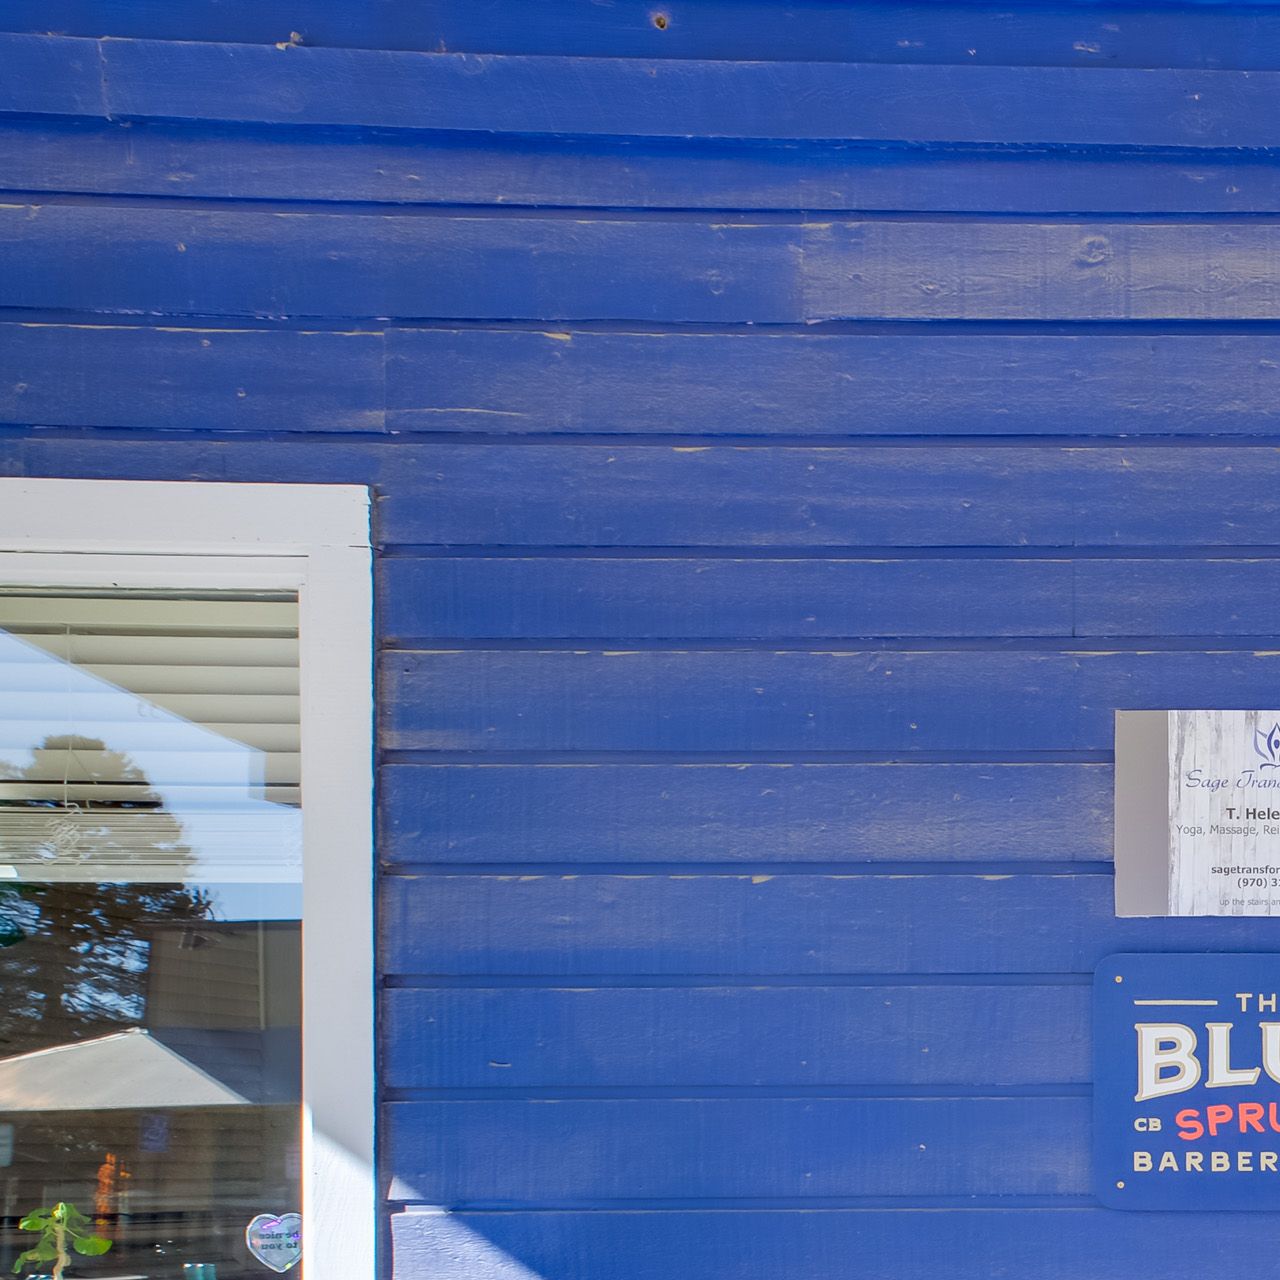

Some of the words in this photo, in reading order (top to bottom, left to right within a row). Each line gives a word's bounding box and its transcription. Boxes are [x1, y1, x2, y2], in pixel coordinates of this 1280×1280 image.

[1185, 769, 1229, 792] Sage
[1226, 808, 1240, 820] T.
[1176, 825, 1206, 837] Yoga,
[1209, 824, 1259, 837] Massage,
[1237, 878, 1268, 889] (970)
[1219, 899, 1230, 908] up
[1232, 898, 1244, 906] the
[1247, 898, 1269, 906] stairs
[1134, 1118, 1161, 1131] CB
[1133, 1151, 1278, 1172] BARBER
